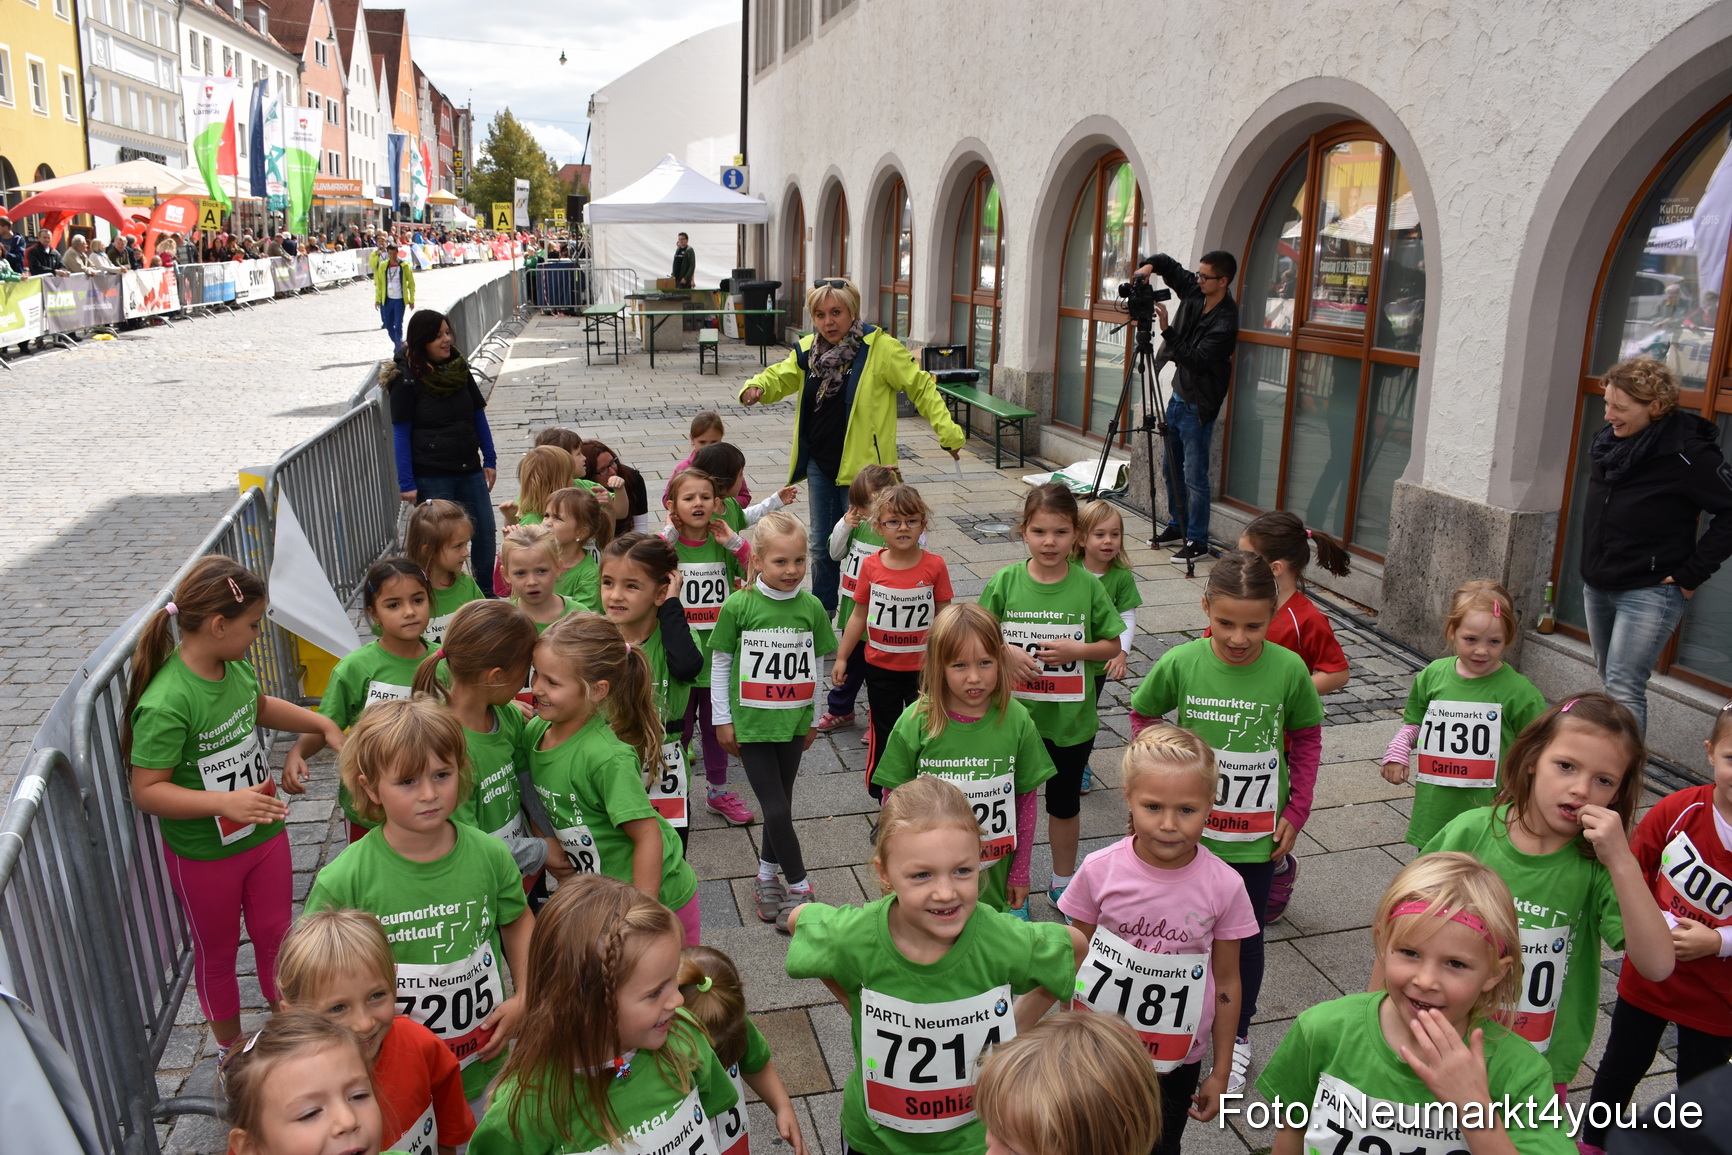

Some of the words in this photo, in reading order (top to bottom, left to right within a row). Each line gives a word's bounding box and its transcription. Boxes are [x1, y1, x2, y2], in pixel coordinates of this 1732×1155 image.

[204, 209, 216, 224] A
[1659, 204, 1695, 214] KulTour
[497, 211, 509, 226] A
[1658, 215, 1689, 224] NACHT
[1700, 214, 1720, 225] 2015
[846, 552, 860, 576] 71
[690, 569, 720, 577] Neumarkt
[686, 578, 726, 605] 029
[872, 590, 890, 601] PARTL
[891, 594, 925, 602] Neumarkt
[686, 611, 715, 621] Anouk
[874, 601, 930, 629] 7172
[1006, 609, 1065, 619] Neumarkter
[882, 634, 918, 644] Antonia
[1002, 629, 1029, 639] PARTL
[1030, 631, 1072, 640] Neumarkt
[743, 639, 770, 648] PARTL
[771, 640, 804, 649] Neumarkt
[749, 651, 811, 681] 7404
[370, 689, 399, 700] PART
[765, 685, 796, 699] EVA
[1027, 680, 1055, 693] Katja
[1186, 695, 1257, 710] Neumarkter
[198, 704, 249, 741] Neumarkter
[1186, 709, 1242, 725] Stadtlauf
[1438, 709, 1483, 720] Neumarkt
[199, 721, 246, 752] Stadtlauf
[1424, 720, 1490, 756] 7130
[203, 757, 240, 776] PARTL
[920, 756, 989, 768] Neumarkter
[1218, 759, 1266, 771] Neumarkt
[1432, 760, 1468, 776] Carina
[216, 752, 270, 797] 718
[963, 788, 1001, 799] eumarkt
[1214, 773, 1271, 808] 077
[972, 799, 1007, 834] 25
[562, 838, 580, 848] arkt
[981, 843, 1012, 859] Klara
[1668, 843, 1732, 916] 700
[376, 902, 461, 926] eumarkter
[387, 921, 445, 944] adtlauf
[1118, 916, 1189, 943] adidas
[1521, 942, 1549, 954] arkt
[1091, 937, 1124, 966] PARTL
[1125, 958, 1188, 979] Neumarkt
[396, 976, 426, 989] RTL
[429, 962, 483, 988] Neumarkt
[1087, 959, 1190, 1028] 7181
[394, 973, 494, 1034] 7205
[865, 1004, 911, 1028] PARTL
[914, 1009, 990, 1030] Neumarkt
[451, 1036, 478, 1058] ima
